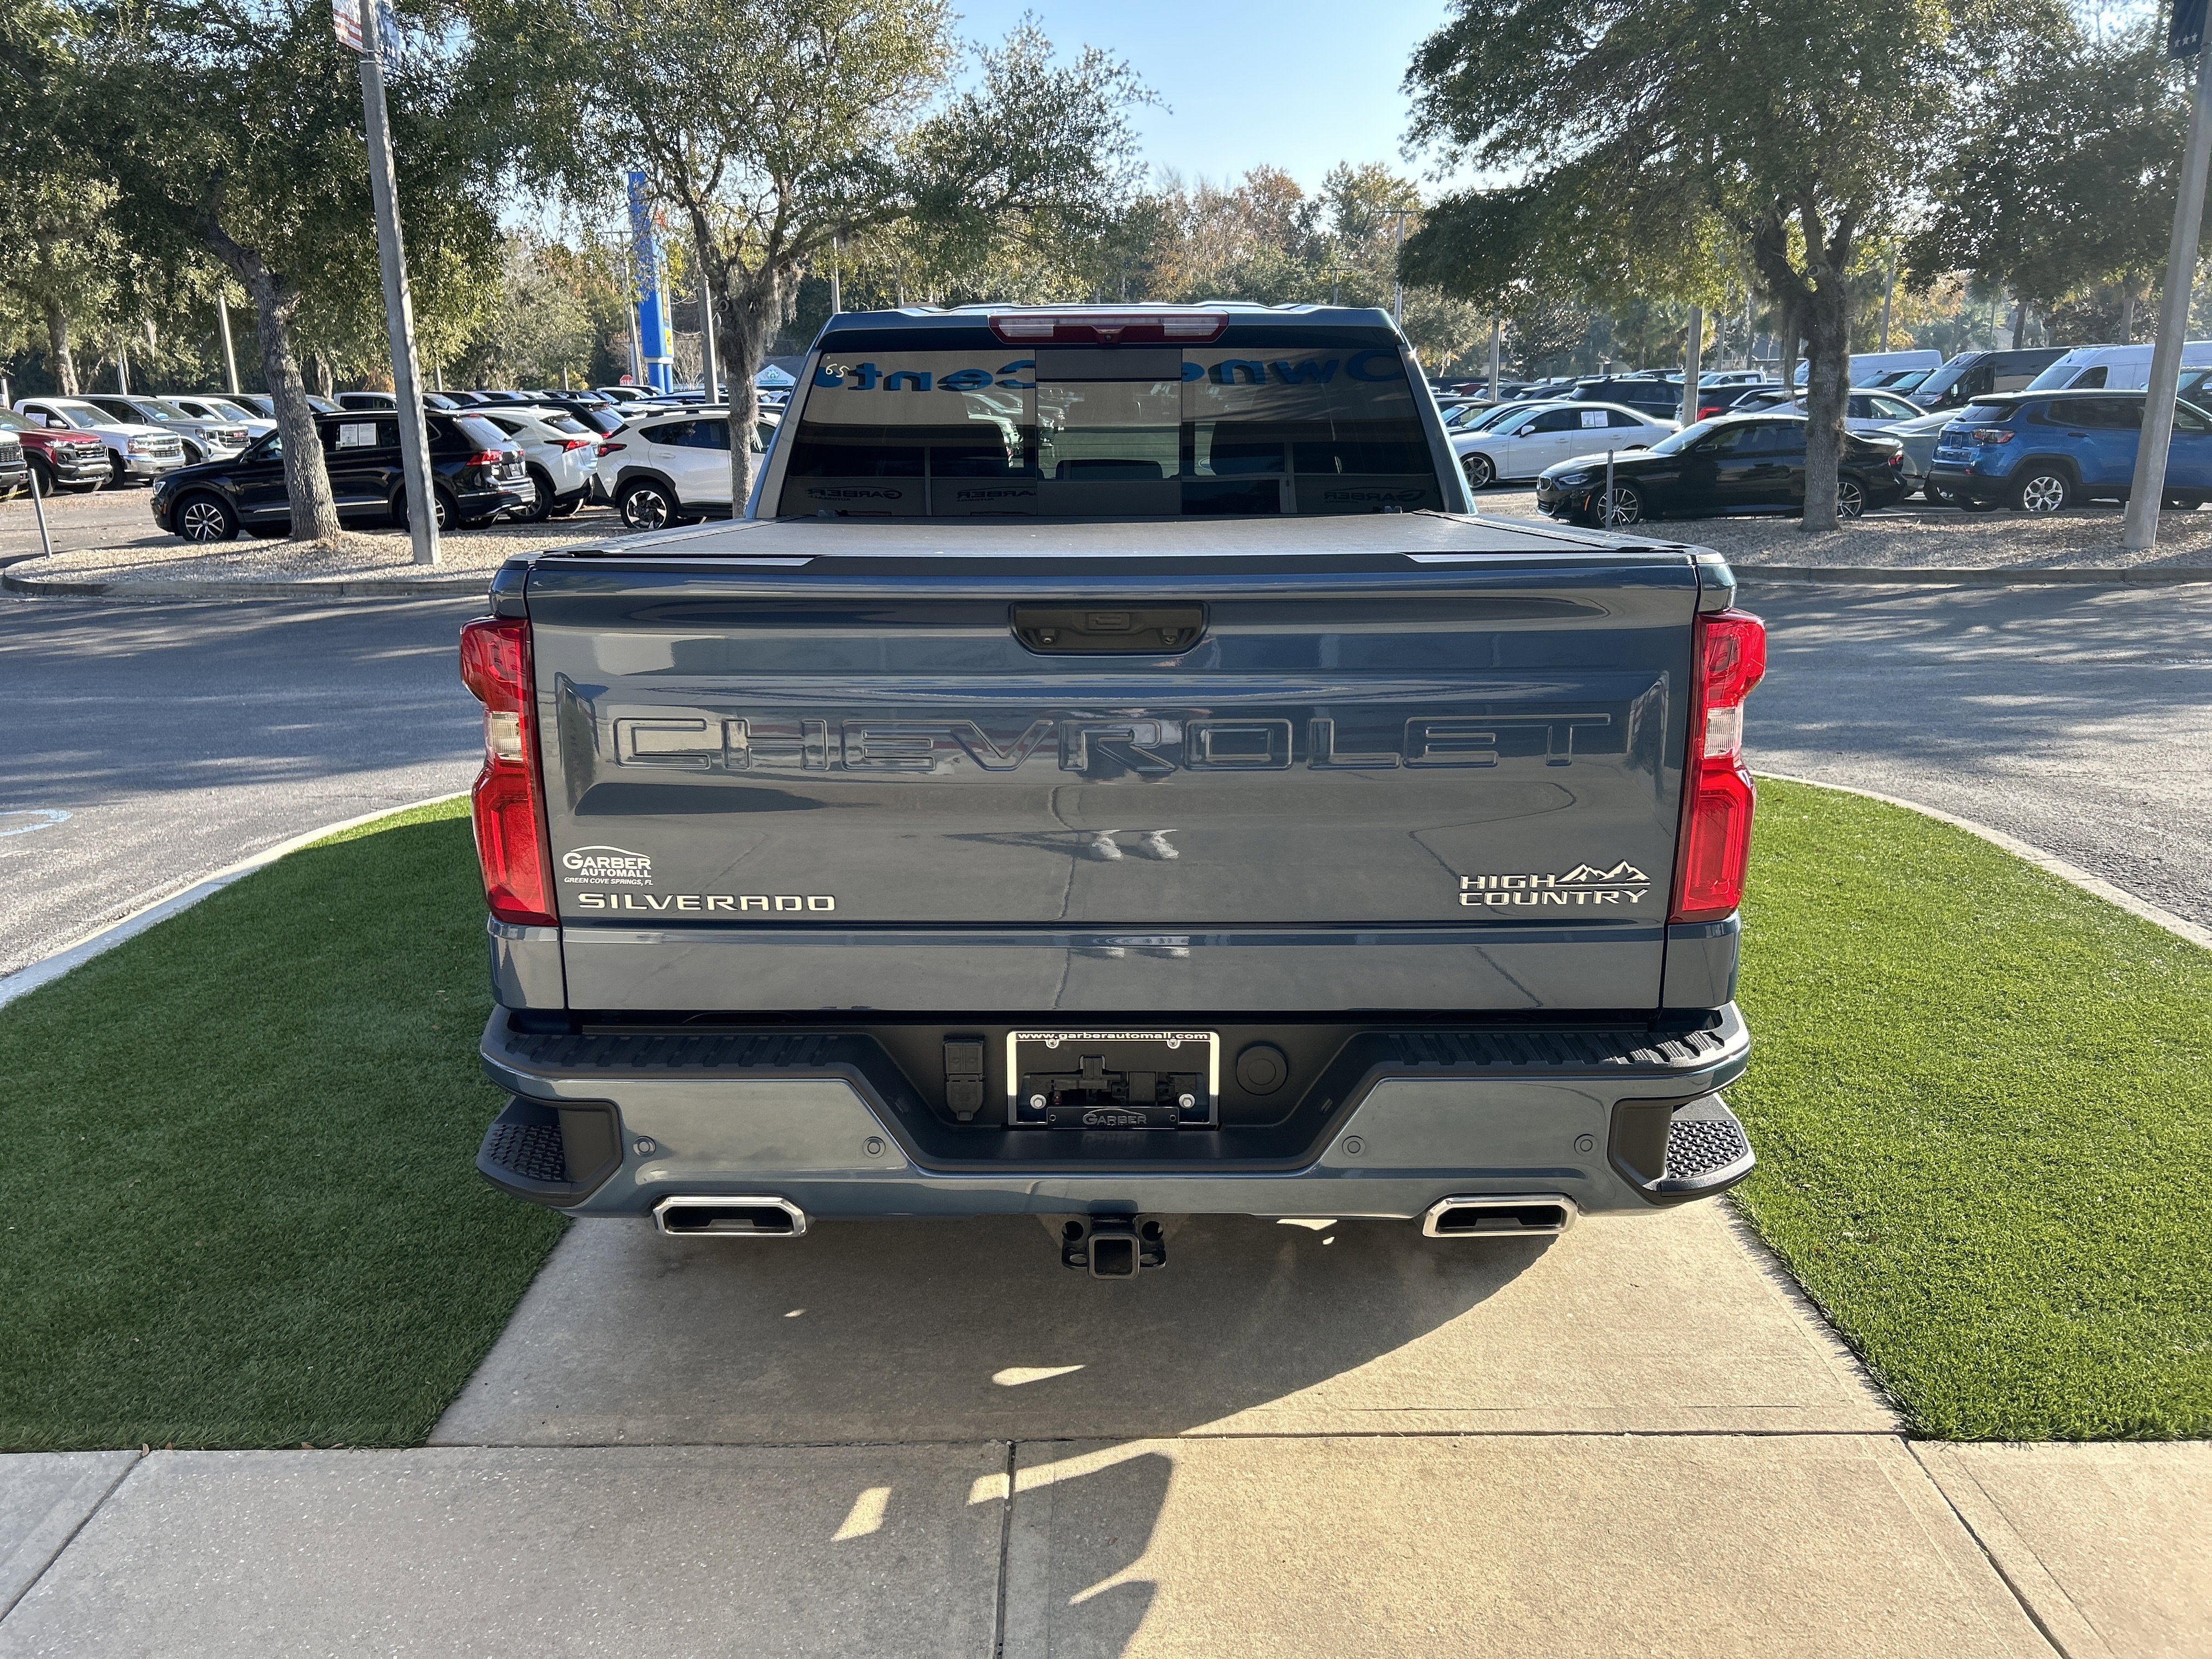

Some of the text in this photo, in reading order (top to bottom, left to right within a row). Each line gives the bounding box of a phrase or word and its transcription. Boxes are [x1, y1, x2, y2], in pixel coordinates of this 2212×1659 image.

[825, 363, 850, 378] 65
[612, 713, 1611, 771] CHEVROLET
[562, 852, 652, 870] GARBER
[580, 868, 652, 878] AUTOMALL
[1459, 873, 1556, 889] HIGH
[578, 892, 836, 911] SILVERADO
[1459, 889, 1648, 906] COUNTRY
[1018, 1032, 1208, 1040] www.garberautomall.com
[1082, 1113, 1147, 1126] GARBER
